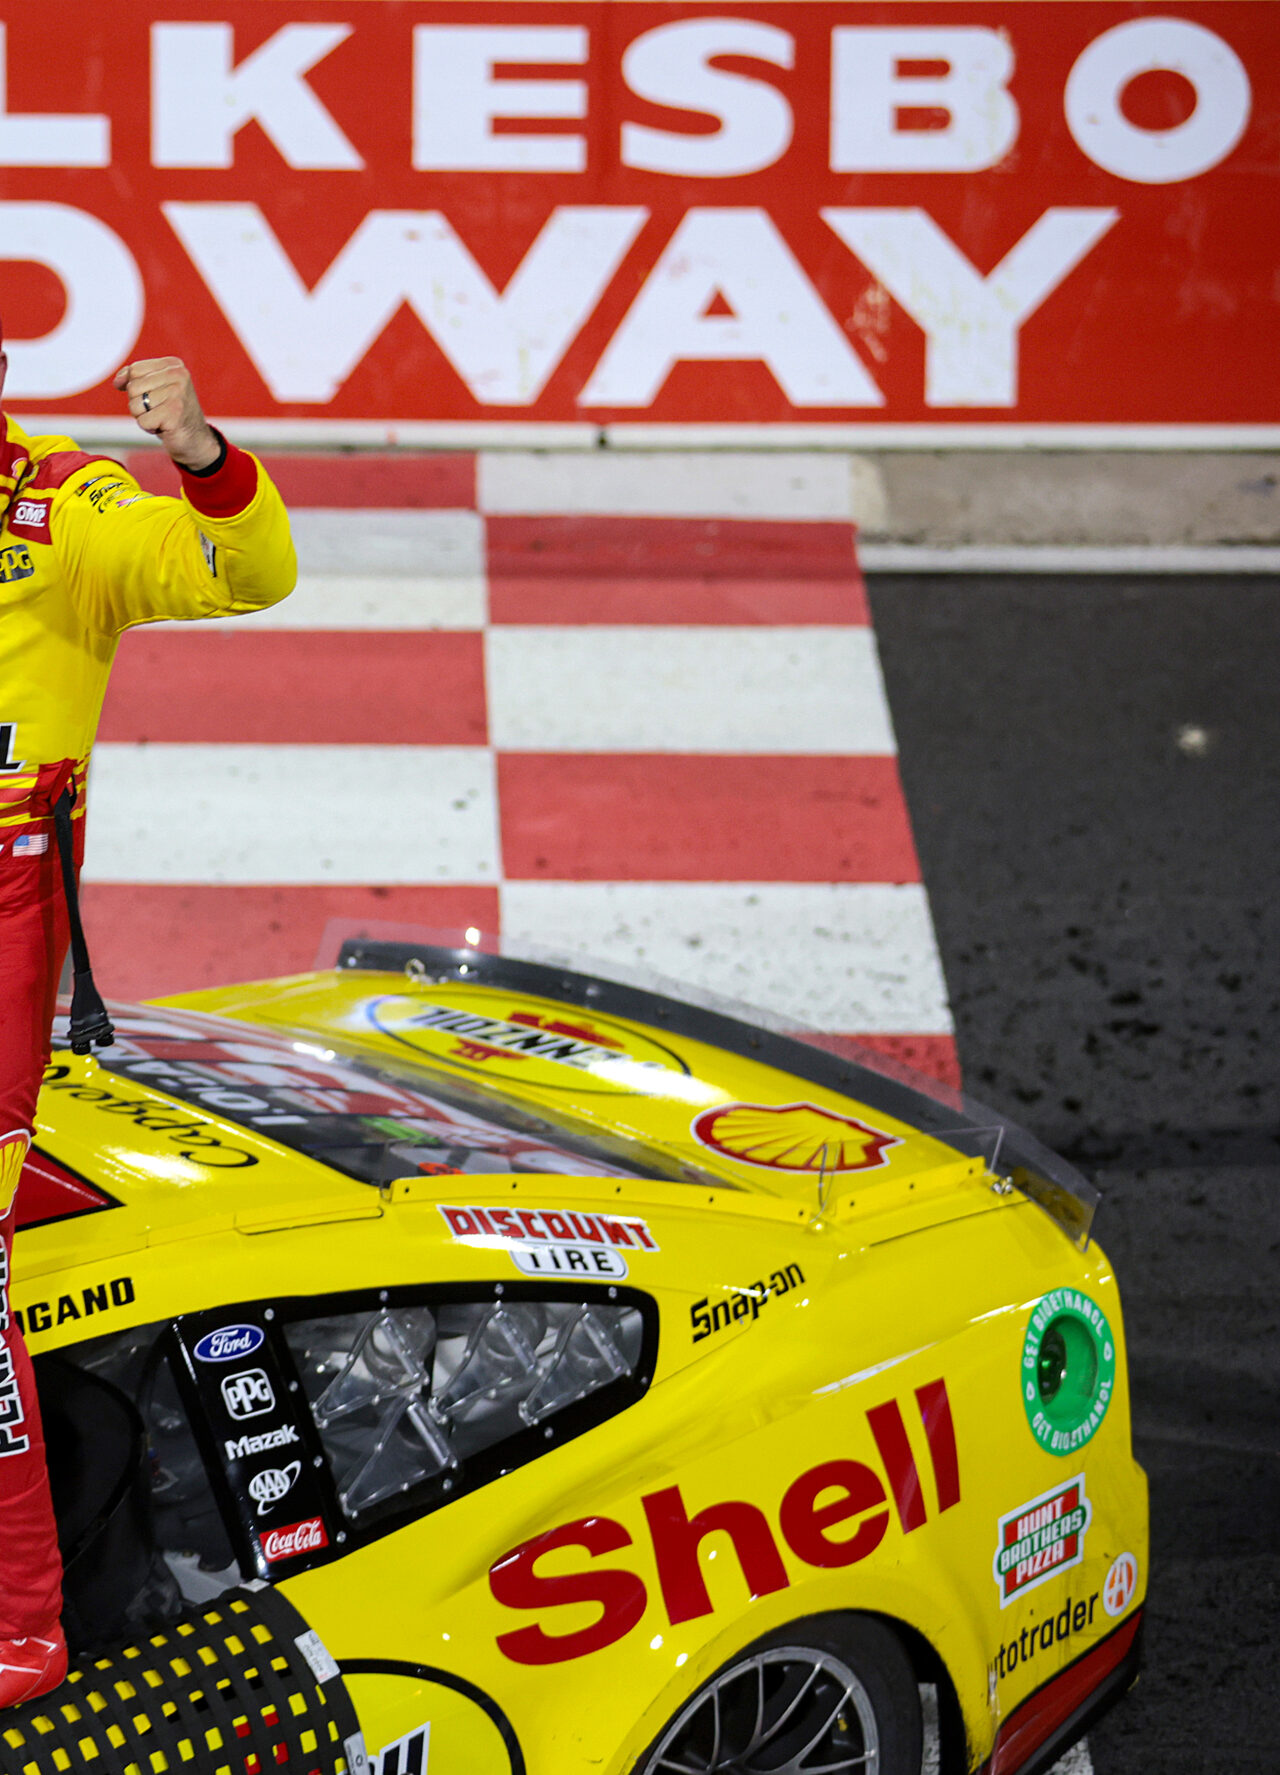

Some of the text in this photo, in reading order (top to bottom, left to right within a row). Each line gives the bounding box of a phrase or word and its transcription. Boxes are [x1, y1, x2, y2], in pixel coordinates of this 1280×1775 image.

[14, 503, 47, 526] OMP
[436, 1204, 661, 1253] DISCOUNT
[528, 1246, 615, 1273] TIRE
[689, 1262, 807, 1344] Snap-on
[209, 1328, 253, 1358] Ford
[1023, 1289, 1105, 1369] GET BIOETHANOL
[225, 1376, 272, 1413] PPG
[1032, 1377, 1113, 1450] GET BIOETHANOL
[224, 1424, 300, 1461] Mazak
[488, 1377, 961, 1666] Shell
[1000, 1508, 1083, 1573] BROTHERS
[1016, 1496, 1065, 1541] HUNT
[1016, 1539, 1065, 1584] PIZZA
